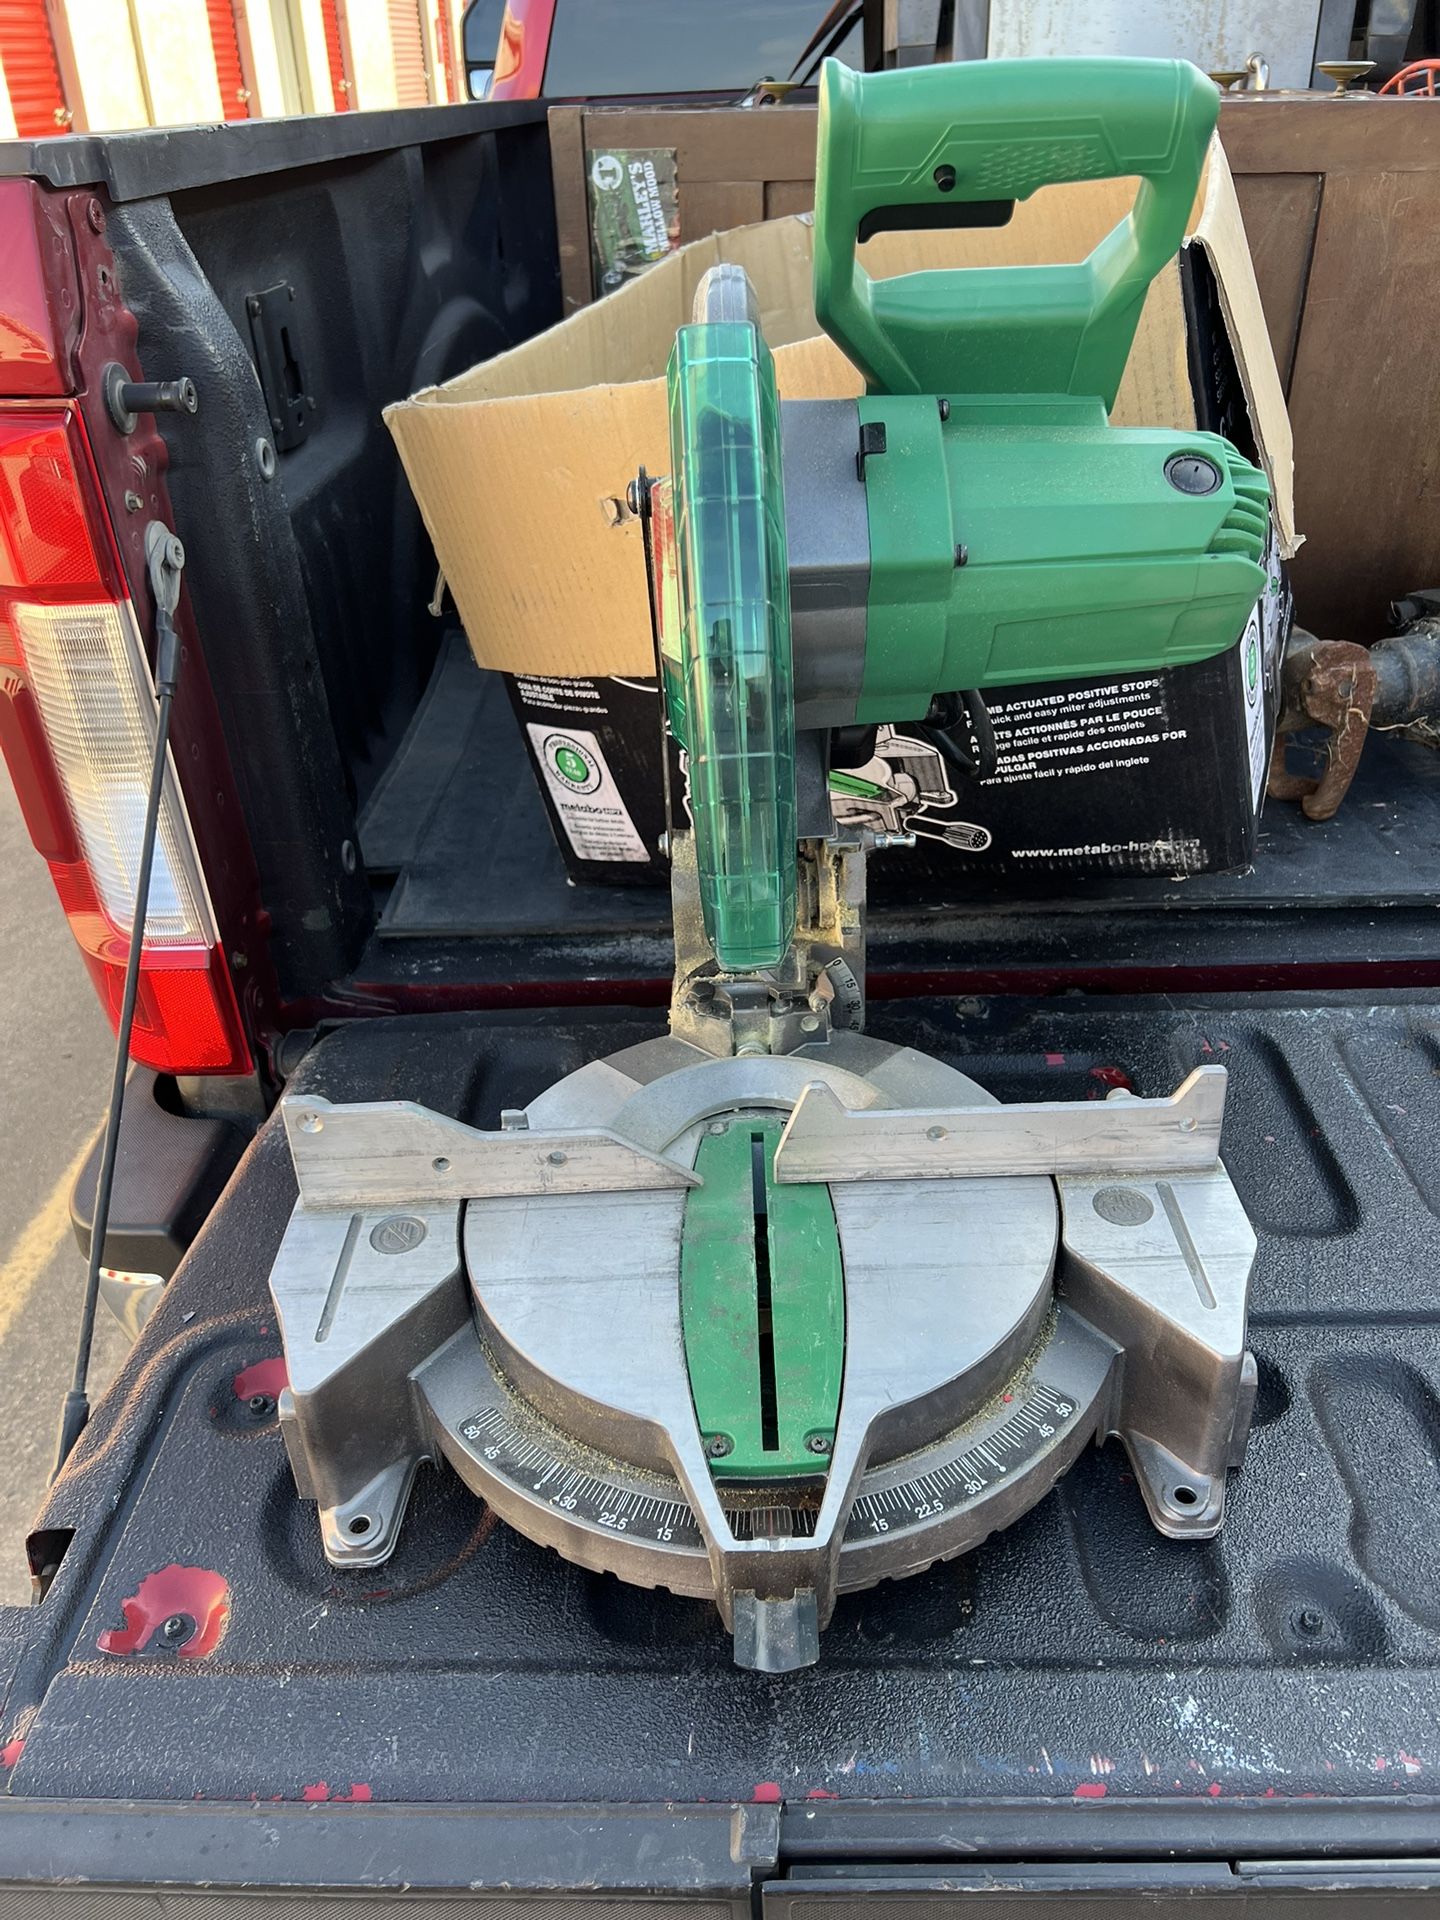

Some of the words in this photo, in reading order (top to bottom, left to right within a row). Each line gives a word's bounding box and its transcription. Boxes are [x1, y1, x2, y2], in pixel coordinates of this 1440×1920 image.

[643, 160, 660, 198] MOOD
[627, 161, 659, 255] MARLEY'S
[651, 200, 671, 252] MELLOW
[542, 686, 564, 696] CORTE
[574, 690, 600, 699] PIVOTE
[1006, 694, 1065, 712] ACTUATED
[1067, 685, 1119, 702] POSITIVE
[1121, 678, 1160, 693] STOPS
[990, 713, 1012, 725] uick
[1013, 710, 1033, 721] and
[1034, 708, 1058, 717] easy
[1059, 702, 1086, 714] miter
[1088, 692, 1152, 708] adjustments
[1014, 720, 1078, 737] ACTIONNÉS
[1080, 715, 1103, 727] PAR
[1105, 712, 1121, 723] LE
[1123, 706, 1163, 720] POUCE
[1013, 736, 1039, 747] facile
[1041, 734, 1052, 743] et
[1053, 728, 1085, 742] rapide
[1087, 727, 1106, 737] des
[1107, 720, 1146, 733] onglets
[1027, 744, 1084, 760] POSITIVAS
[1086, 734, 1160, 752] ACCIONADAS
[1162, 730, 1187, 741] POR
[564, 751, 577, 769] 5
[1003, 772, 1033, 784] ajuste
[1034, 768, 1055, 779] fácil
[1056, 768, 1063, 777] y
[1065, 760, 1097, 776] rápido
[1098, 758, 1114, 770] del
[1116, 754, 1150, 769] inglete
[560, 803, 602, 815] metabo
[832, 959, 842, 967] 0
[844, 978, 857, 989] 15
[850, 1000, 861, 1011] 30
[1055, 1402, 1073, 1418] 50
[463, 1425, 480, 1440] 50
[1038, 1422, 1055, 1438] 45
[484, 1444, 501, 1460] 45
[964, 1480, 982, 1495] 30
[558, 1495, 577, 1511] 30
[914, 1499, 944, 1519] 22.5
[597, 1512, 628, 1531] 22.5
[871, 1518, 889, 1532] 15
[656, 1526, 673, 1541] 15
